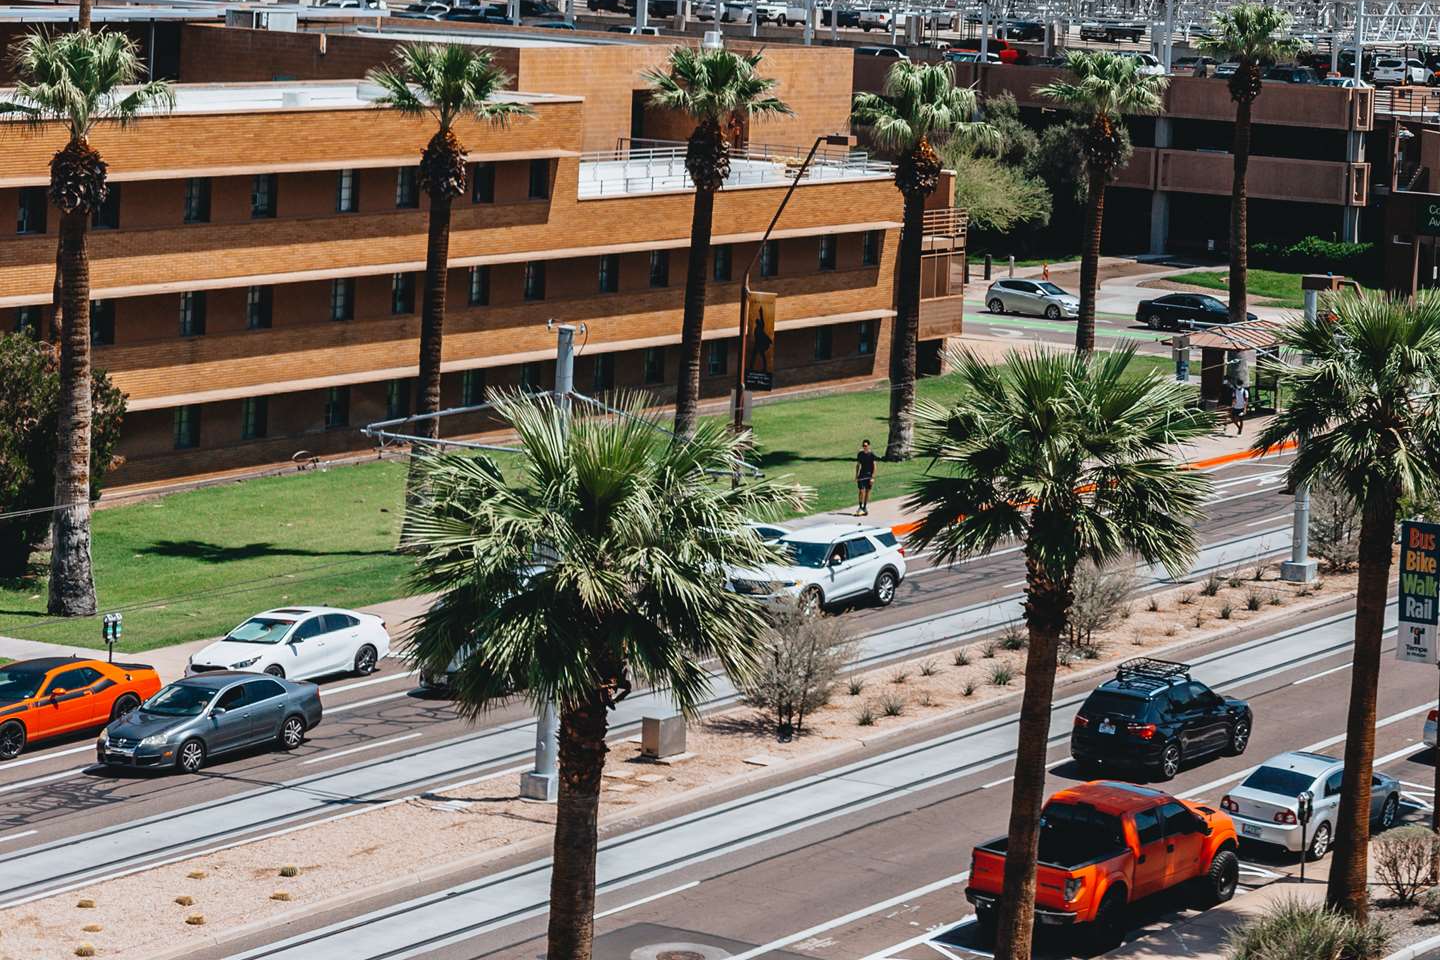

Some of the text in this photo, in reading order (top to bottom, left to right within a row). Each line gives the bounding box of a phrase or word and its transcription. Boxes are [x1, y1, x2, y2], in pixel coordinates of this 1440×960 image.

[1409, 527, 1436, 551] Bus
[1405, 550, 1438, 574] Bike
[1402, 573, 1438, 598] Walk
[1405, 596, 1433, 620] Rail
